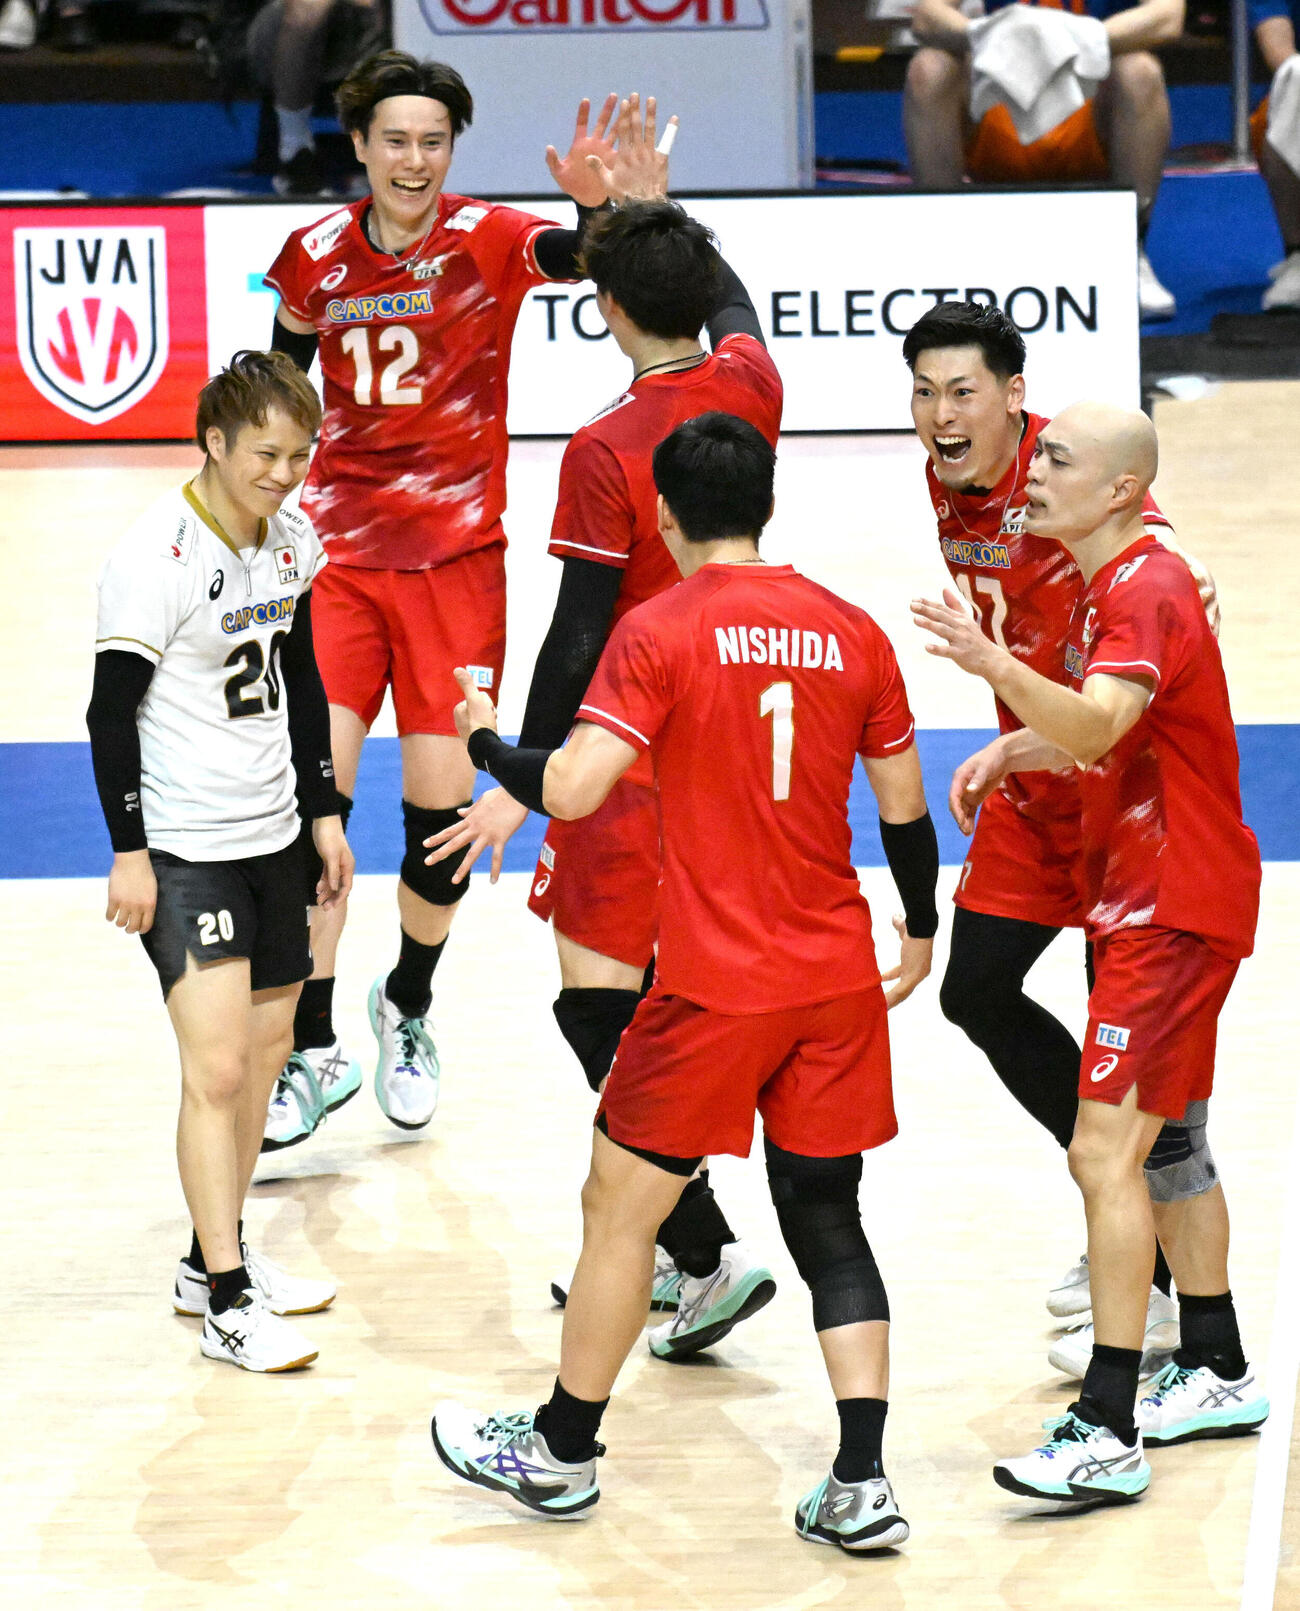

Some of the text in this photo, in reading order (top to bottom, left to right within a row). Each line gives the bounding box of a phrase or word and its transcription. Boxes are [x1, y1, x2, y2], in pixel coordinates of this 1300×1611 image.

[40, 238, 137, 284] JVA
[325, 289, 434, 323] CAPCOM
[341, 325, 423, 406] 12
[942, 537, 1011, 568] CAPCOM
[283, 570, 299, 582] JPN
[220, 595, 295, 635] CAPCOM
[714, 625, 844, 672] NISHIDA
[222, 629, 288, 720] 20
[759, 681, 795, 801] 1
[124, 791, 139, 812] 20
[197, 909, 235, 946] 20
[1098, 1026, 1126, 1047] TEL
